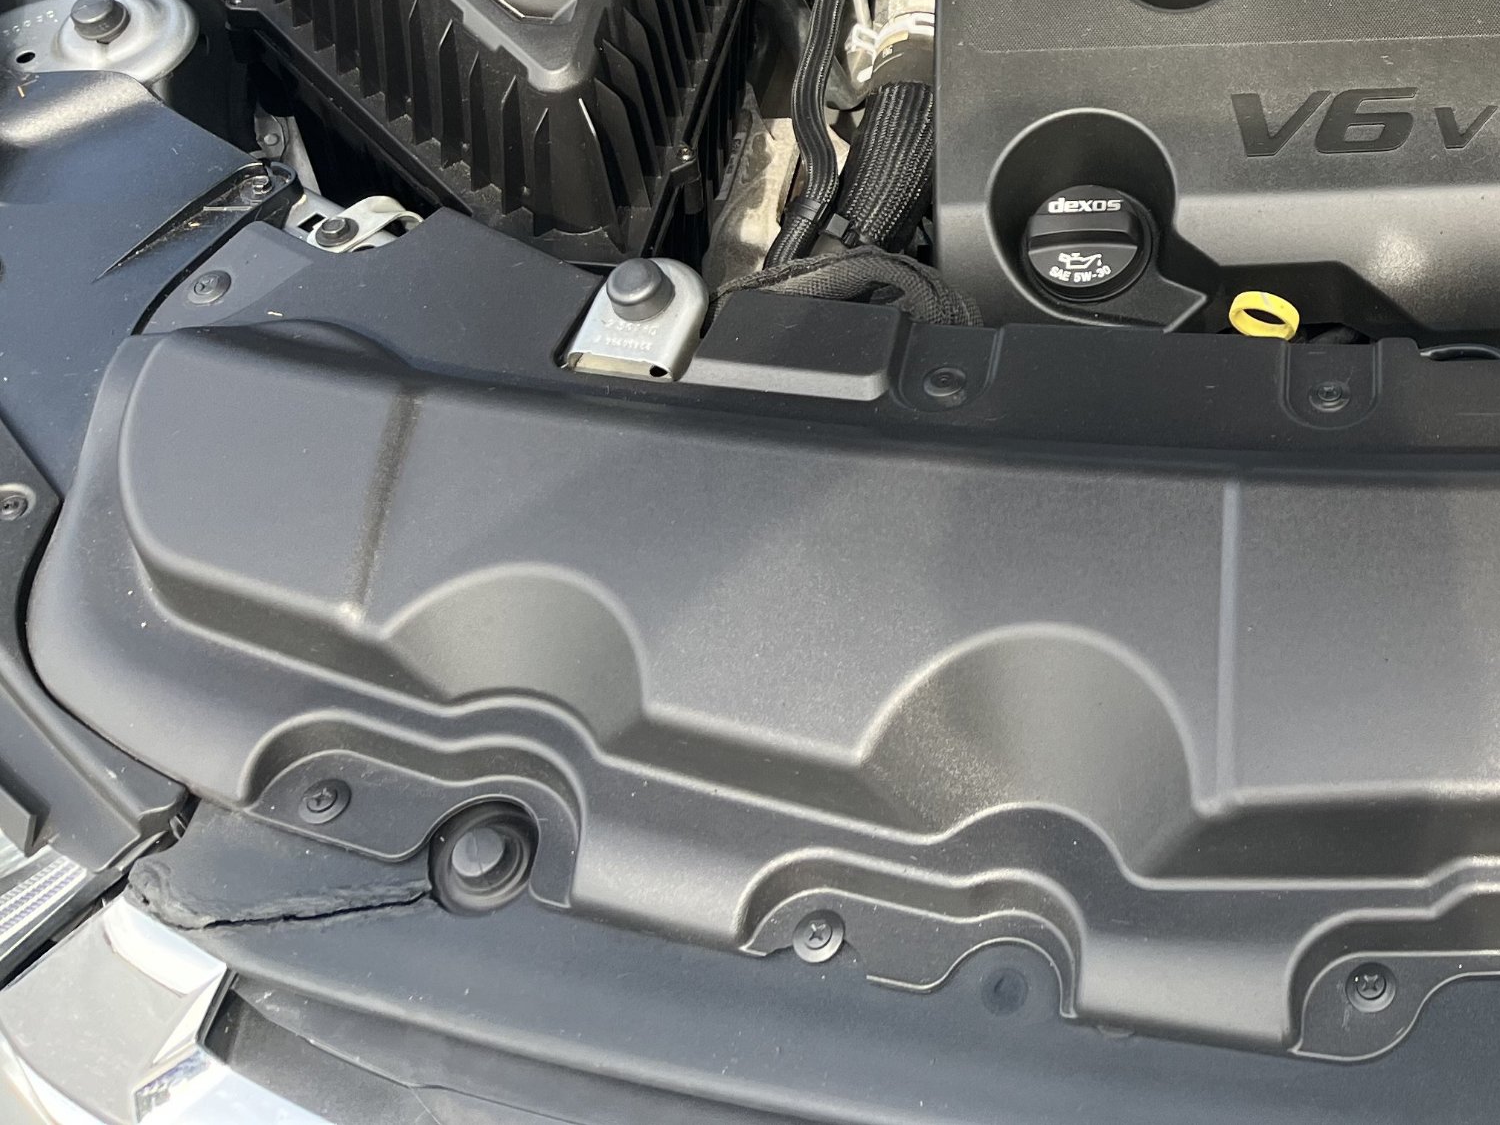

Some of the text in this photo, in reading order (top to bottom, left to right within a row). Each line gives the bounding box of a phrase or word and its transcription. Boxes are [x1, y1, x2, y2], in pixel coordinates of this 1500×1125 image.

[1231, 86, 1419, 158] V6
[1048, 197, 1124, 214] dexos
[1049, 265, 1111, 283] SAE 5W-30
